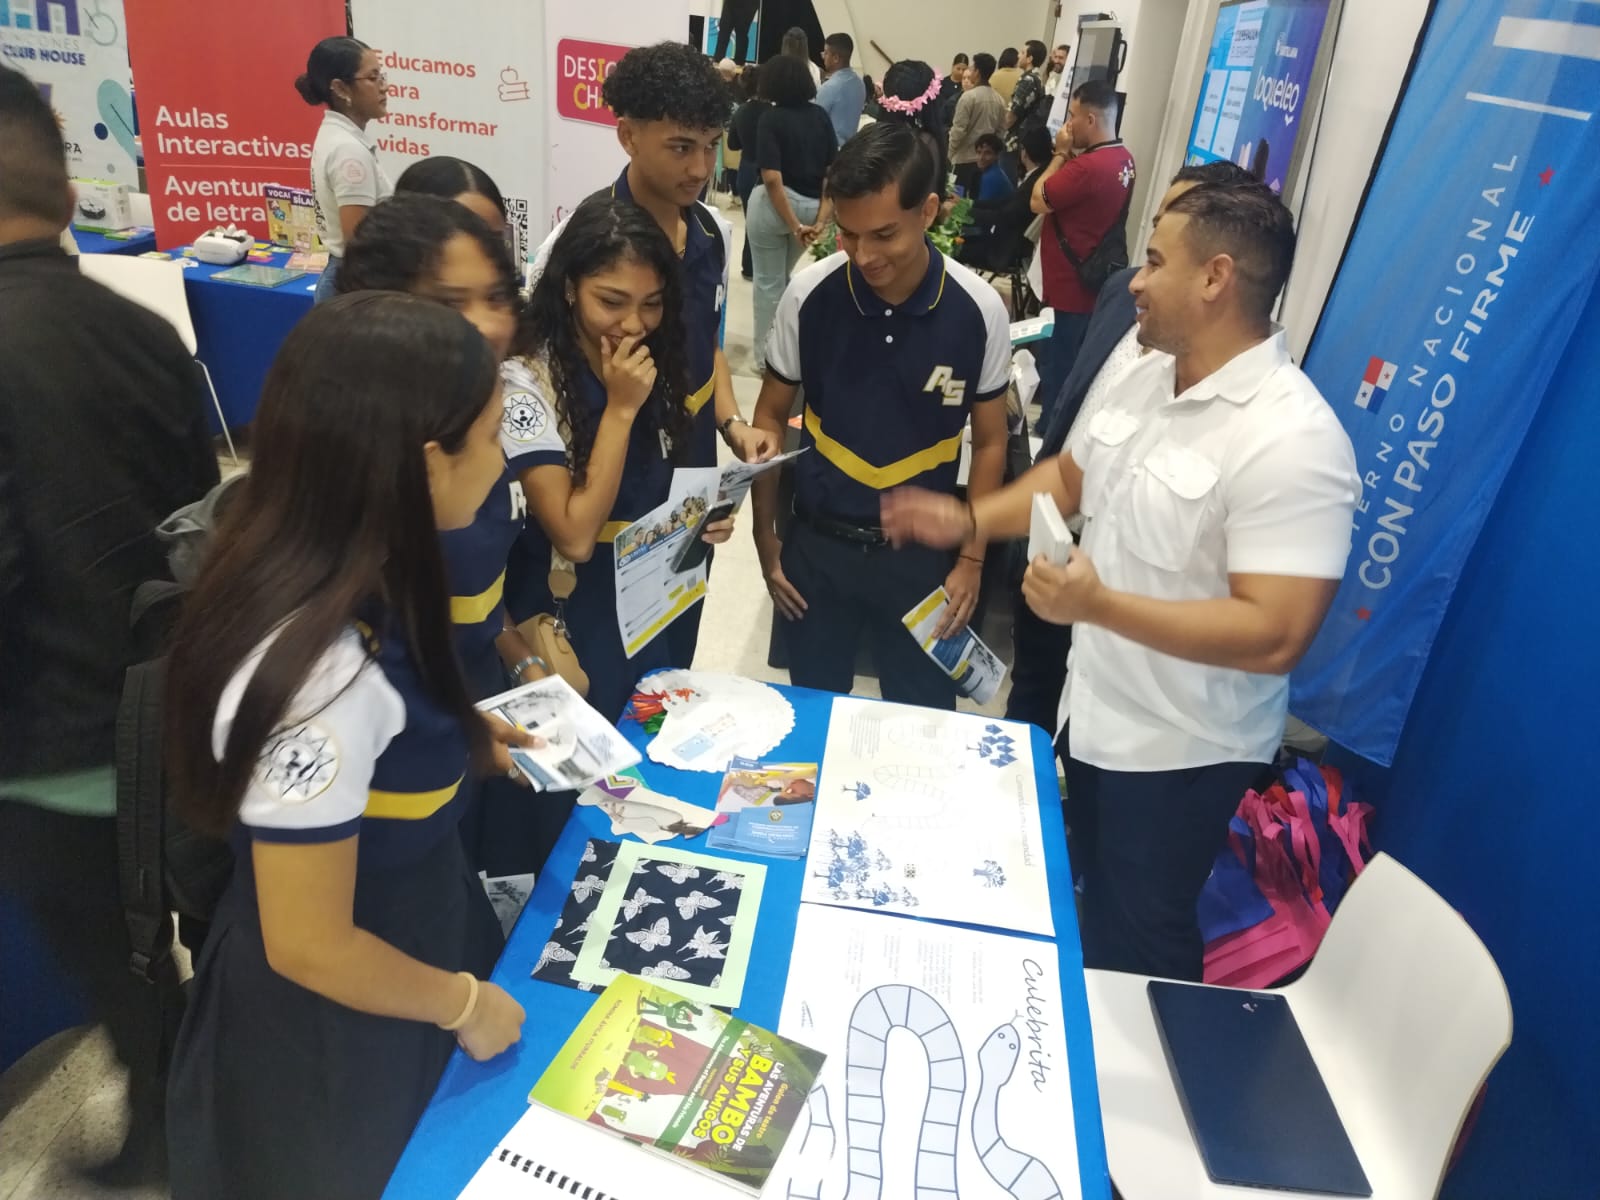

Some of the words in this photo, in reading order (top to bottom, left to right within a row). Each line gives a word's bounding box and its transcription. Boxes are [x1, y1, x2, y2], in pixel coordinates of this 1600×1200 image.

[40, 48, 86, 66] HOUSE
[387, 84, 420, 100] ara
[155, 105, 229, 129] Aulas
[157, 132, 312, 159] Interactivas
[377, 134, 430, 156] vidas
[164, 175, 281, 197] Aventur
[167, 202, 200, 222] de
[207, 202, 267, 222] letra
[1408, 155, 1518, 387] NACIONAL
[1359, 496, 1414, 589] CON
[1393, 373, 1456, 492] PASO
[1450, 211, 1536, 363] FIRME
[1022, 958, 1051, 1093] Culebrita
[737, 1047, 752, 1059] Y
[724, 1057, 745, 1084] SUS
[769, 1061, 785, 1081] LAS
[692, 1083, 730, 1138] AMIGOS
[711, 1053, 774, 1145] BAMBO
[740, 1079, 775, 1138] AVENTURAS
[731, 1137, 746, 1152] DE
